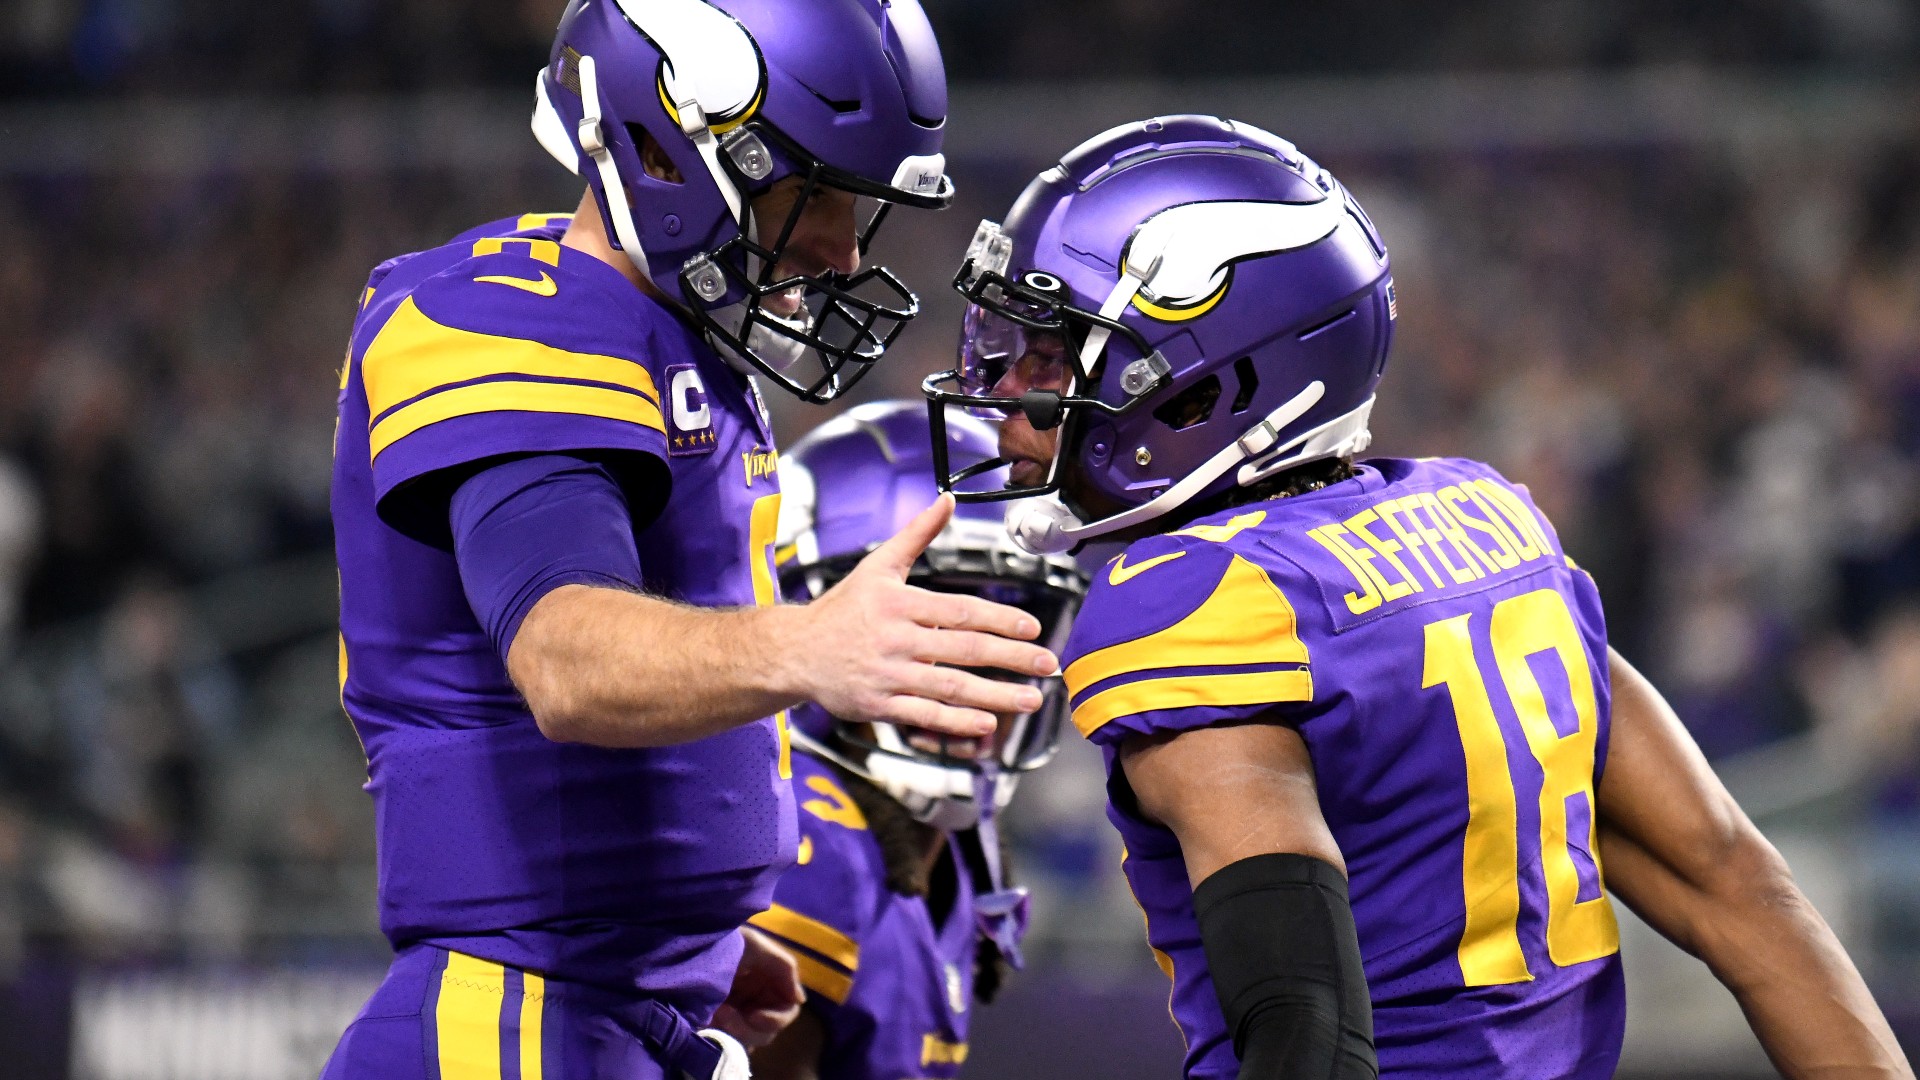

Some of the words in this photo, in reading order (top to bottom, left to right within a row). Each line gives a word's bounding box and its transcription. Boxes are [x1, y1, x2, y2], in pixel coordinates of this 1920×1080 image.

[671, 369, 711, 432] C
[1305, 478, 1556, 615] JEFFERSON
[1421, 588, 1620, 987] 18
